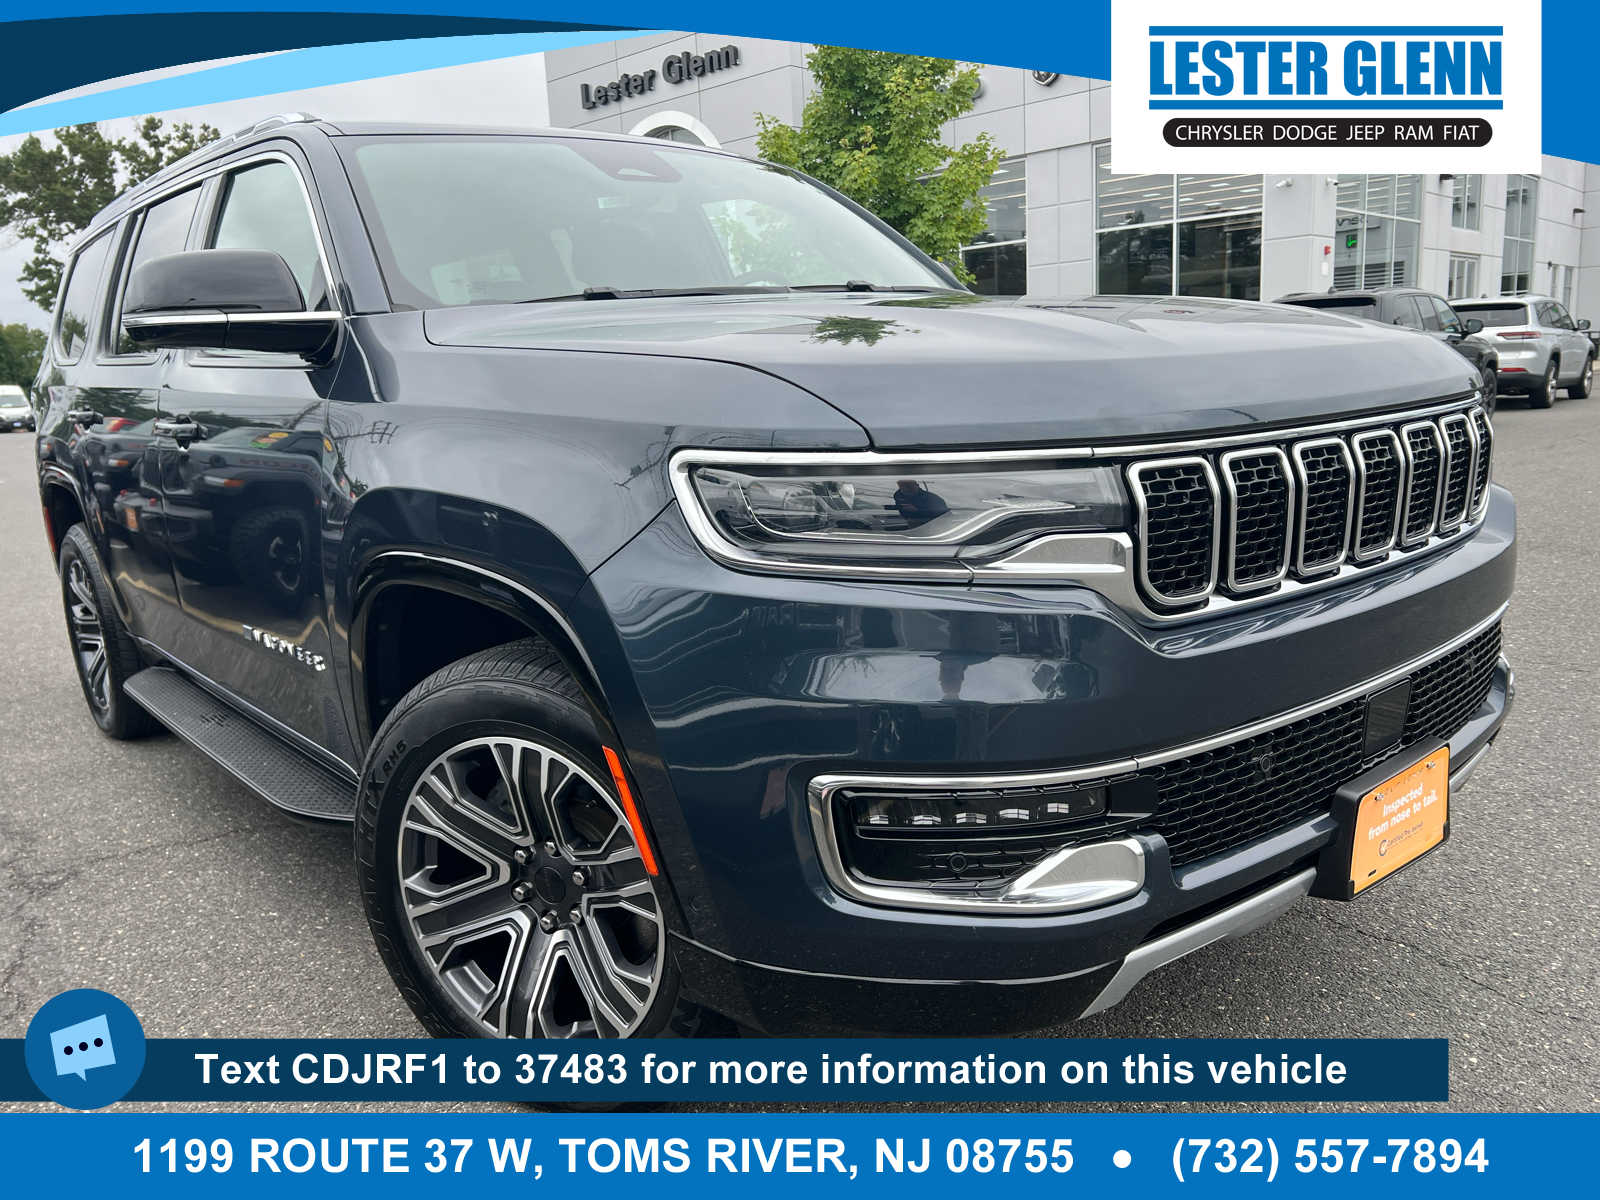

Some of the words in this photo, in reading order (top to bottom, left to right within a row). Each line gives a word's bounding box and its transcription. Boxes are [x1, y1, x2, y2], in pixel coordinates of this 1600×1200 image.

[580, 69, 656, 110] Lester
[662, 44, 741, 84] Glenn
[1383, 783, 1424, 816] Inspected
[1368, 820, 1389, 840] from
[1390, 808, 1411, 825] nose
[1413, 801, 1421, 814] to
